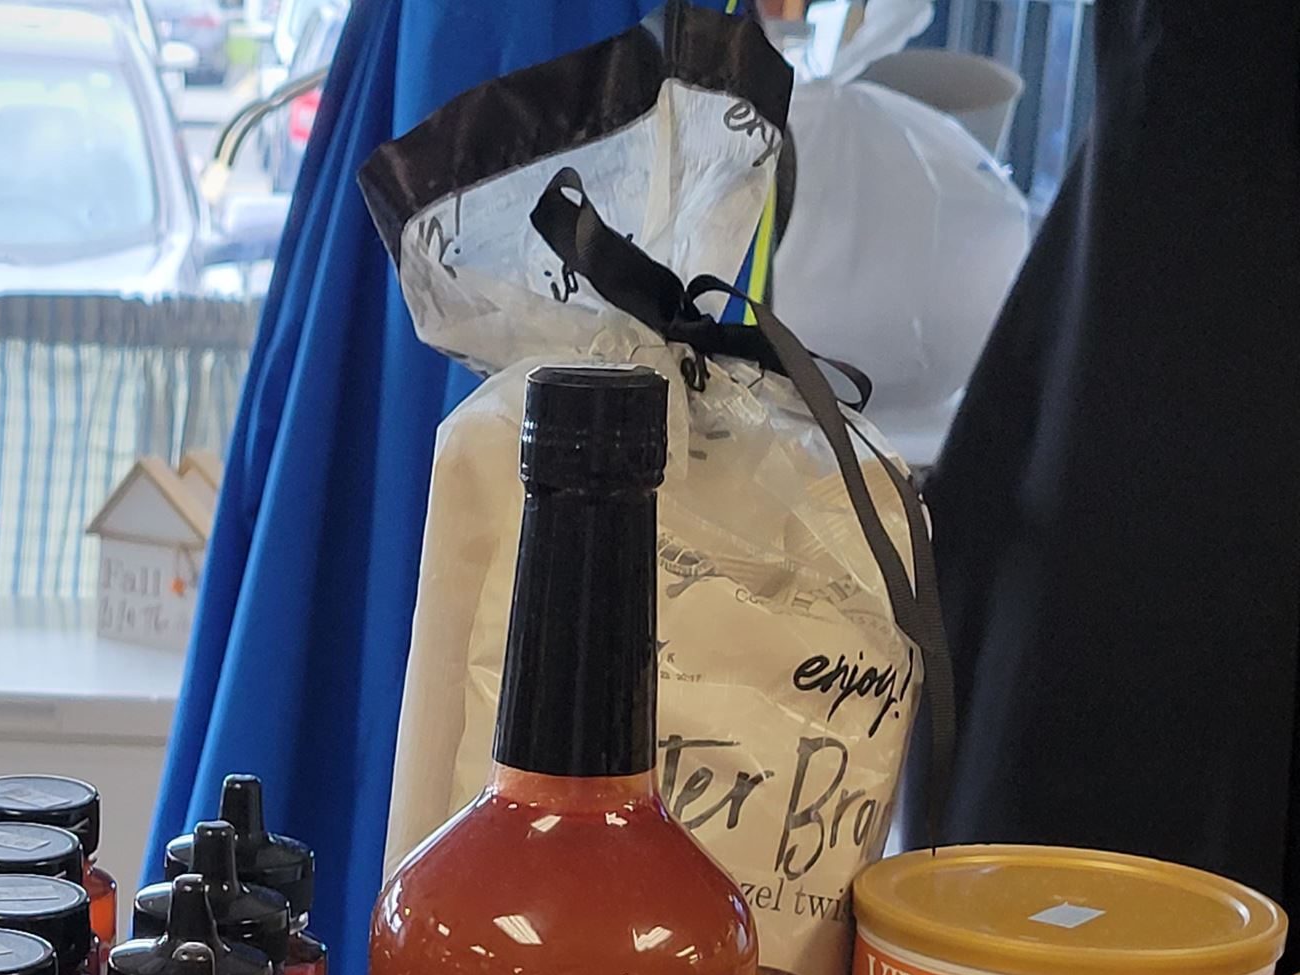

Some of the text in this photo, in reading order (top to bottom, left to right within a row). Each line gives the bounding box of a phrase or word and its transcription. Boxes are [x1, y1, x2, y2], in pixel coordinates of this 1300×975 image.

[793, 648, 913, 738] enjoy!
[774, 736, 880, 882] Bra
[738, 877, 848, 922] zel twi
